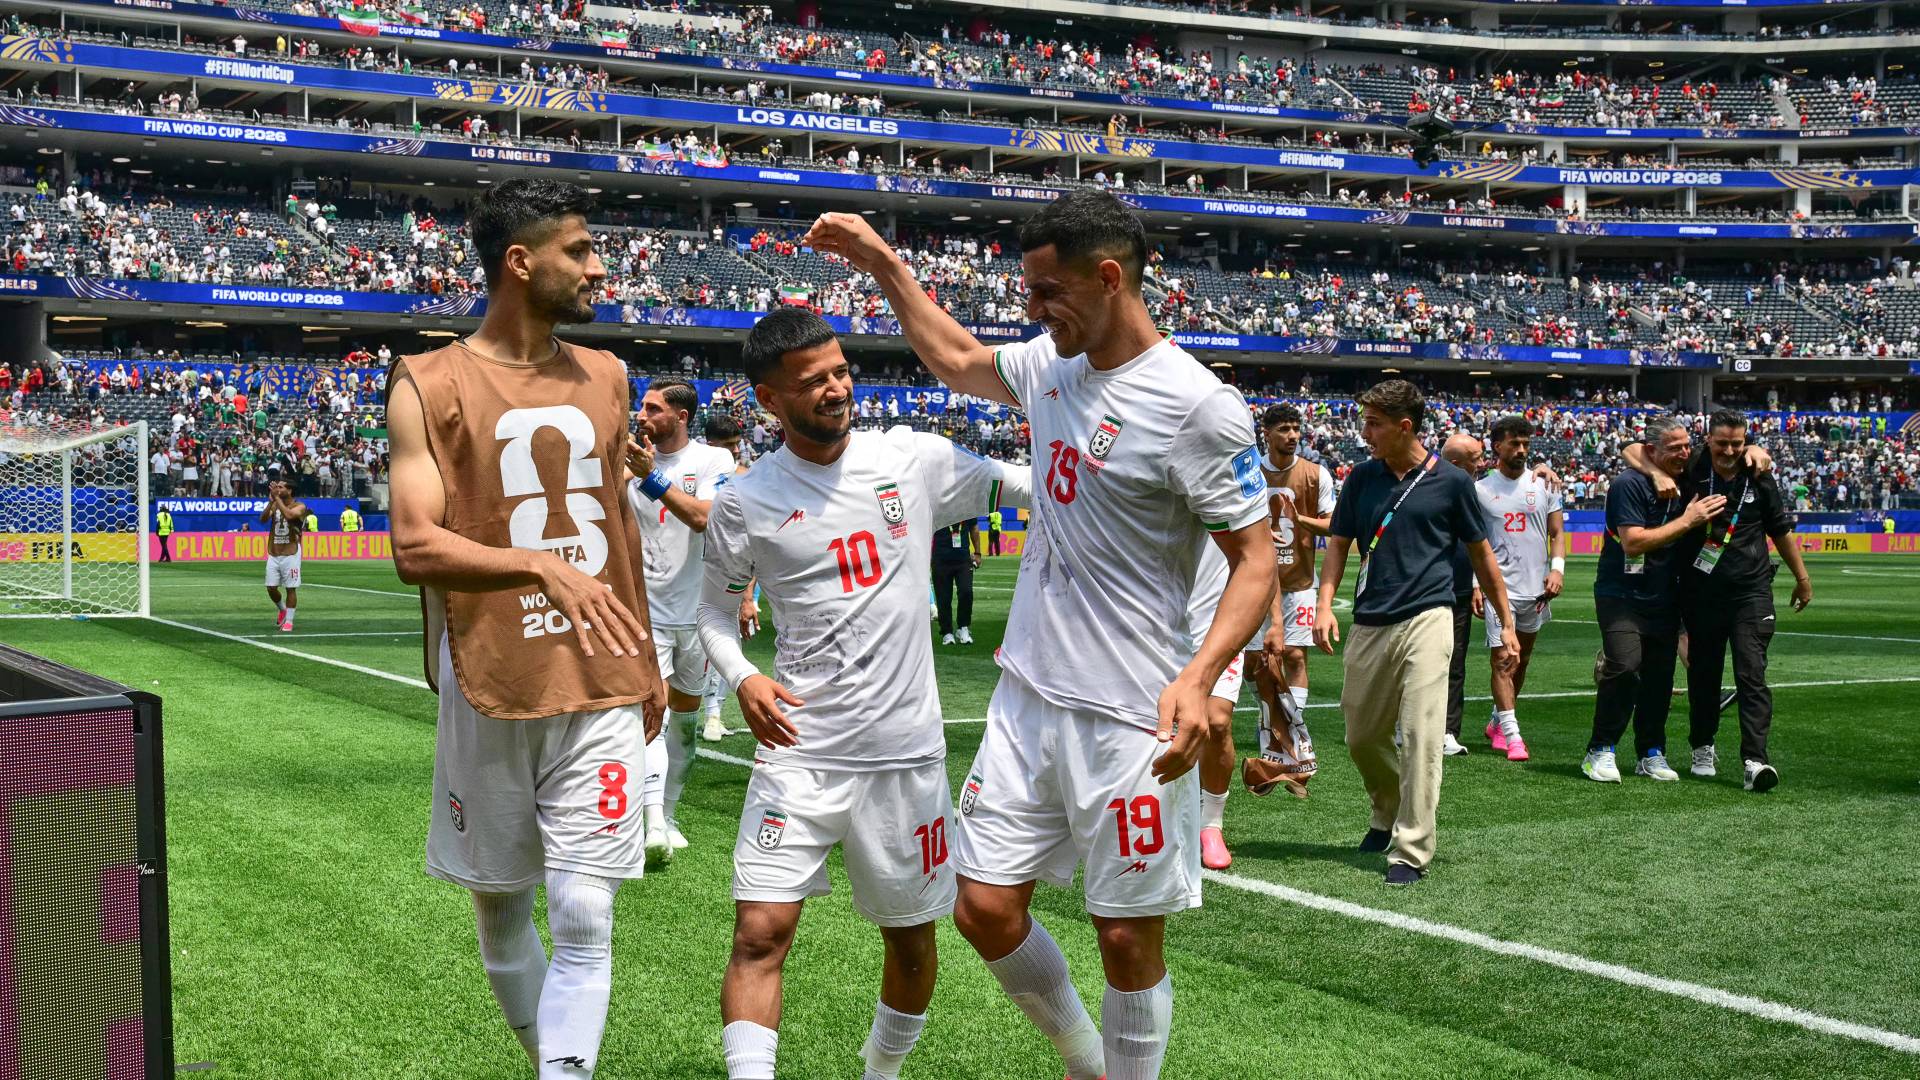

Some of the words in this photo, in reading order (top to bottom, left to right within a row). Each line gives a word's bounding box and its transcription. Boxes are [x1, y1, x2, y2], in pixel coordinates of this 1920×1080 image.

[204, 59, 294, 84] #FIFAWorldCup
[144, 120, 170, 133] FIFA
[172, 122, 217, 137] WORLD
[218, 127, 243, 138] CUP
[244, 129, 287, 142] 2026
[738, 109, 785, 126] LOS
[791, 112, 899, 136] ANGELES
[472, 147, 495, 159] LOS
[497, 149, 551, 163] ANGELES
[1560, 170, 1588, 183] FIFA
[1588, 170, 1640, 184] WORLD
[1642, 171, 1671, 184] CUP
[1672, 172, 1722, 185] 2026
[992, 187, 1012, 197] LOS
[1014, 188, 1060, 200] ANGELES
[1204, 202, 1224, 212] FIFA
[1224, 203, 1256, 214] WORLD
[1257, 205, 1275, 215] CUP
[1275, 206, 1307, 217] 2026
[1443, 216, 1462, 226] LOS
[1463, 217, 1505, 228] ANGELES
[212, 289, 238, 300] FIFA
[238, 291, 279, 303] WORLD
[280, 294, 304, 303] CUP
[304, 295, 344, 305] 2026
[1194, 336, 1210, 345] CUP
[1211, 337, 1240, 346] 2026
[1355, 343, 1372, 352] LOS
[1736, 361, 1750, 370] CC
[1046, 439, 1080, 505] 19
[158, 501, 183, 512] FIFA
[184, 501, 228, 512] WORLD
[229, 502, 253, 512] CUP
[255, 502, 269, 512] 20
[1503, 511, 1527, 533] 23
[32, 541, 84, 559] FIFA
[176, 536, 229, 558] PLAY.
[302, 536, 352, 558] HAVE
[1824, 539, 1848, 551] FIFA
[826, 530, 883, 594] 10
[522, 609, 591, 640] 20
[1296, 606, 1314, 626] 26
[598, 762, 628, 820] 8
[1106, 794, 1165, 857] 19
[914, 816, 949, 875] 10
